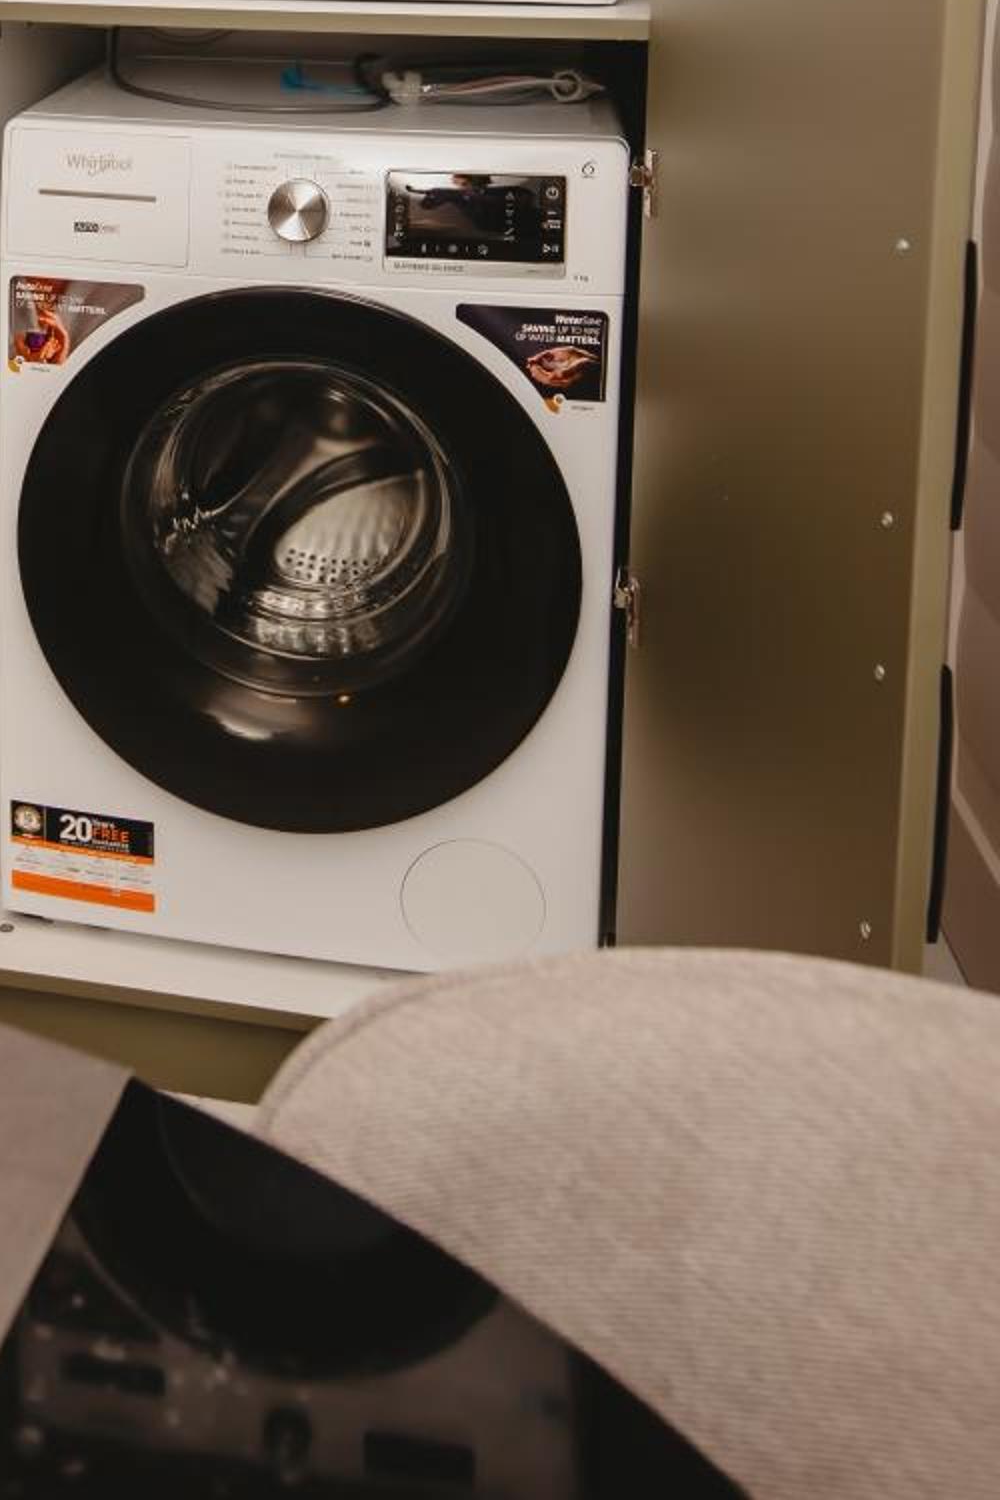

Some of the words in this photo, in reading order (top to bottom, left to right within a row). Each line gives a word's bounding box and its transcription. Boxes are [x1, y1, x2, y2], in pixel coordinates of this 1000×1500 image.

[66, 153, 132, 176] Whirlpool
[59, 814, 92, 841] 20
[92, 826, 130, 844] FREE
